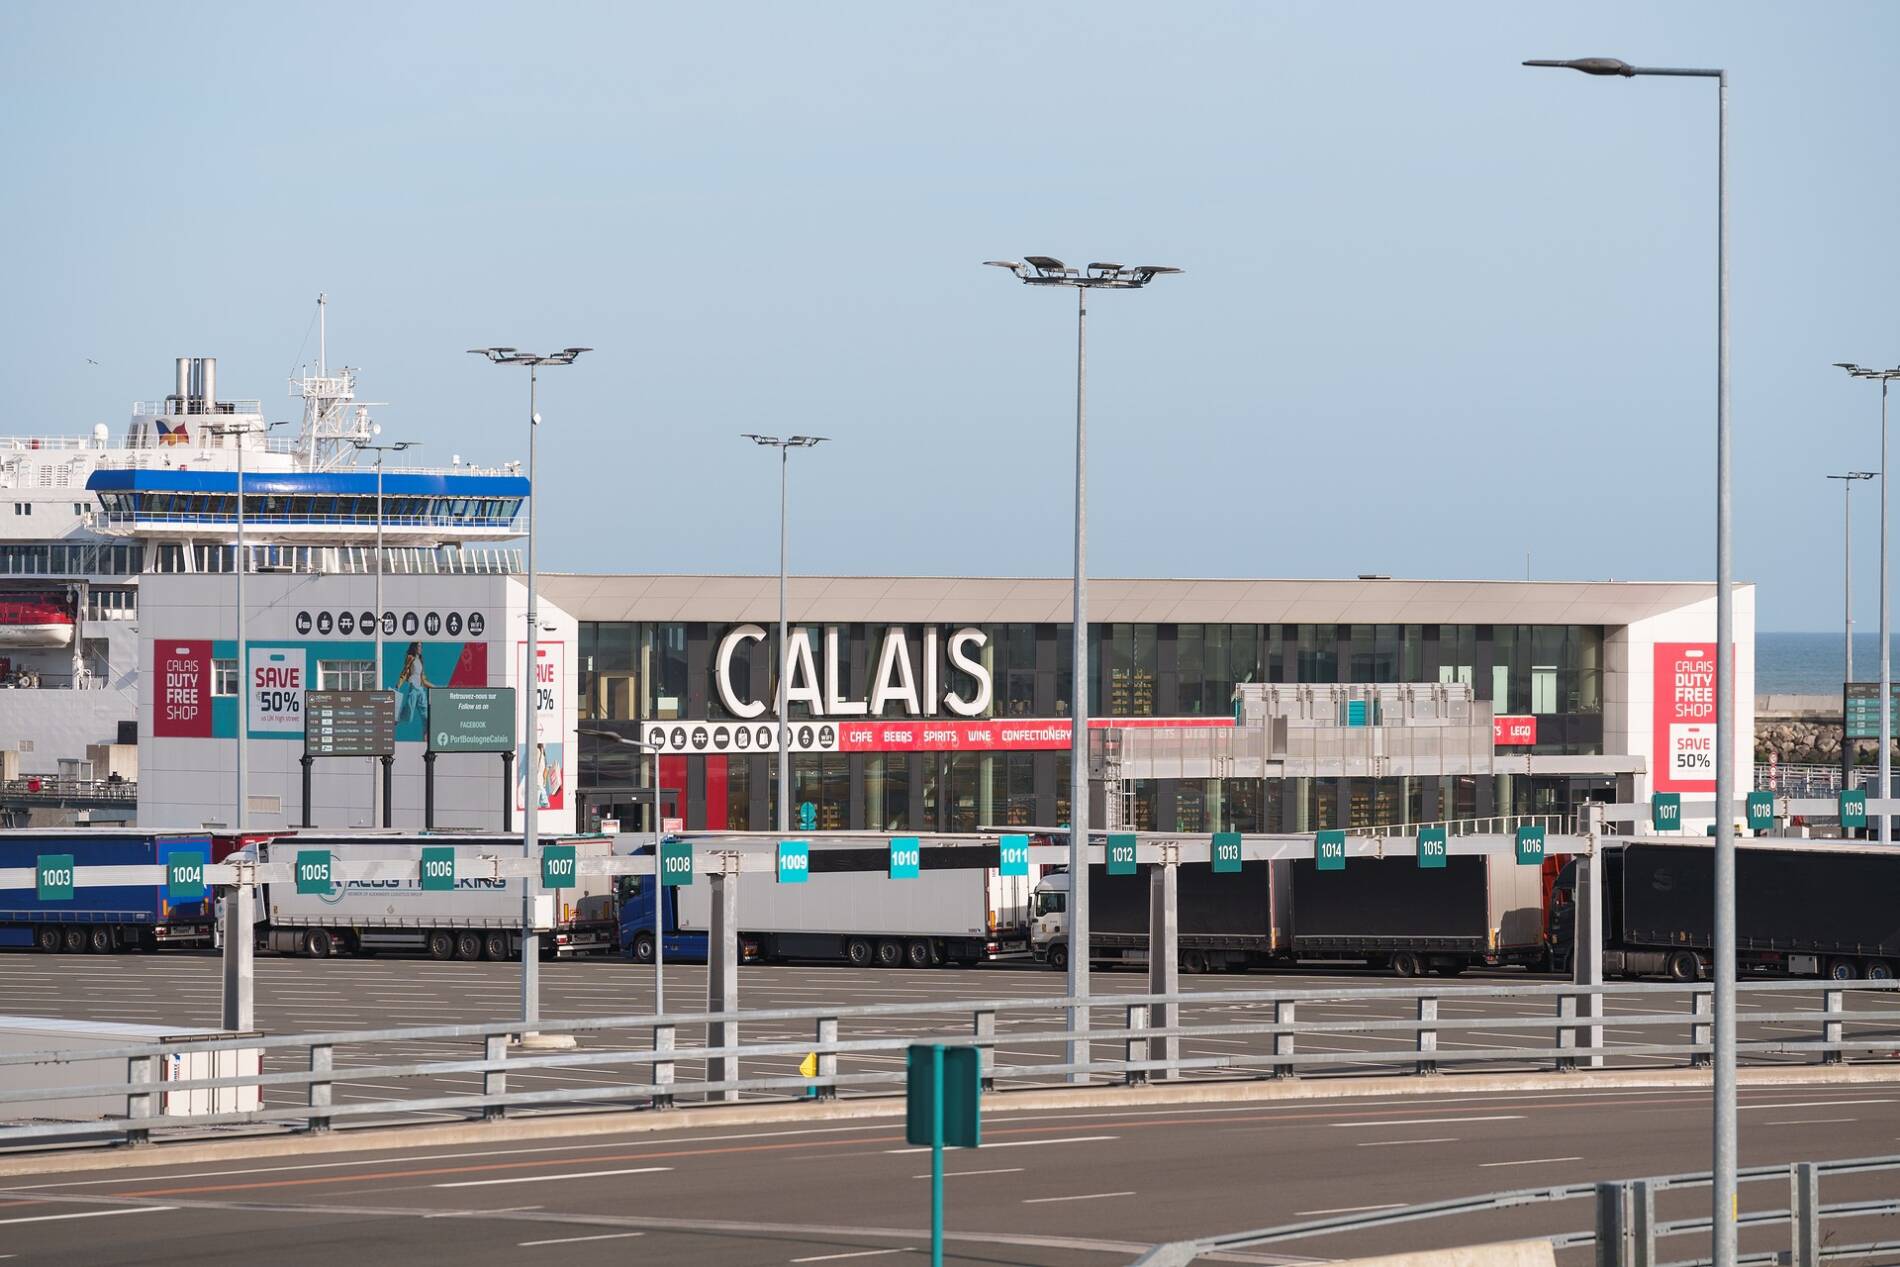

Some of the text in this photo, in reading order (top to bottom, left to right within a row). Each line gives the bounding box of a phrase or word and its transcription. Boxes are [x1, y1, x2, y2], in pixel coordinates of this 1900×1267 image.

[166, 660, 199, 672] CALAIS
[716, 624, 992, 718] CALAIS
[1675, 661, 1713, 673] CALAIS
[255, 668, 300, 688] SAVE
[537, 664, 554, 683] AVE
[1675, 674, 1713, 687] DUTY
[166, 674, 198, 688] DUTY
[166, 689, 198, 704] FREE
[261, 691, 299, 712] 50%
[537, 689, 554, 710] 0%
[1675, 688, 1713, 702] FREE
[166, 706, 198, 720] SHOP
[1675, 704, 1713, 718] SHOP
[850, 728, 1072, 743] CAFE BEERS SPIRITS WINE CONFECTIONERY
[1510, 725, 1531, 736] LEGO
[450, 734, 508, 744] PortBoulogneCalais
[1677, 738, 1711, 750] SAVE
[1677, 753, 1711, 768] 50%
[1659, 805, 1677, 818] 1017
[1753, 803, 1771, 817] 1018
[1846, 803, 1863, 815] 1019
[1219, 845, 1238, 859] 1013
[1322, 843, 1341, 857] 1014
[1423, 841, 1443, 855] 1015
[1522, 839, 1542, 852] 1016
[892, 851, 918, 865] 1010
[1002, 848, 1027, 862] 1011
[1112, 847, 1133, 861] 1012
[426, 861, 452, 876] 1006
[547, 860, 573, 874] 1007
[665, 857, 690, 872] 1008
[780, 855, 807, 869] 1009
[43, 870, 71, 885] 1003
[174, 867, 201, 882] 1004
[302, 865, 329, 880] 1005
